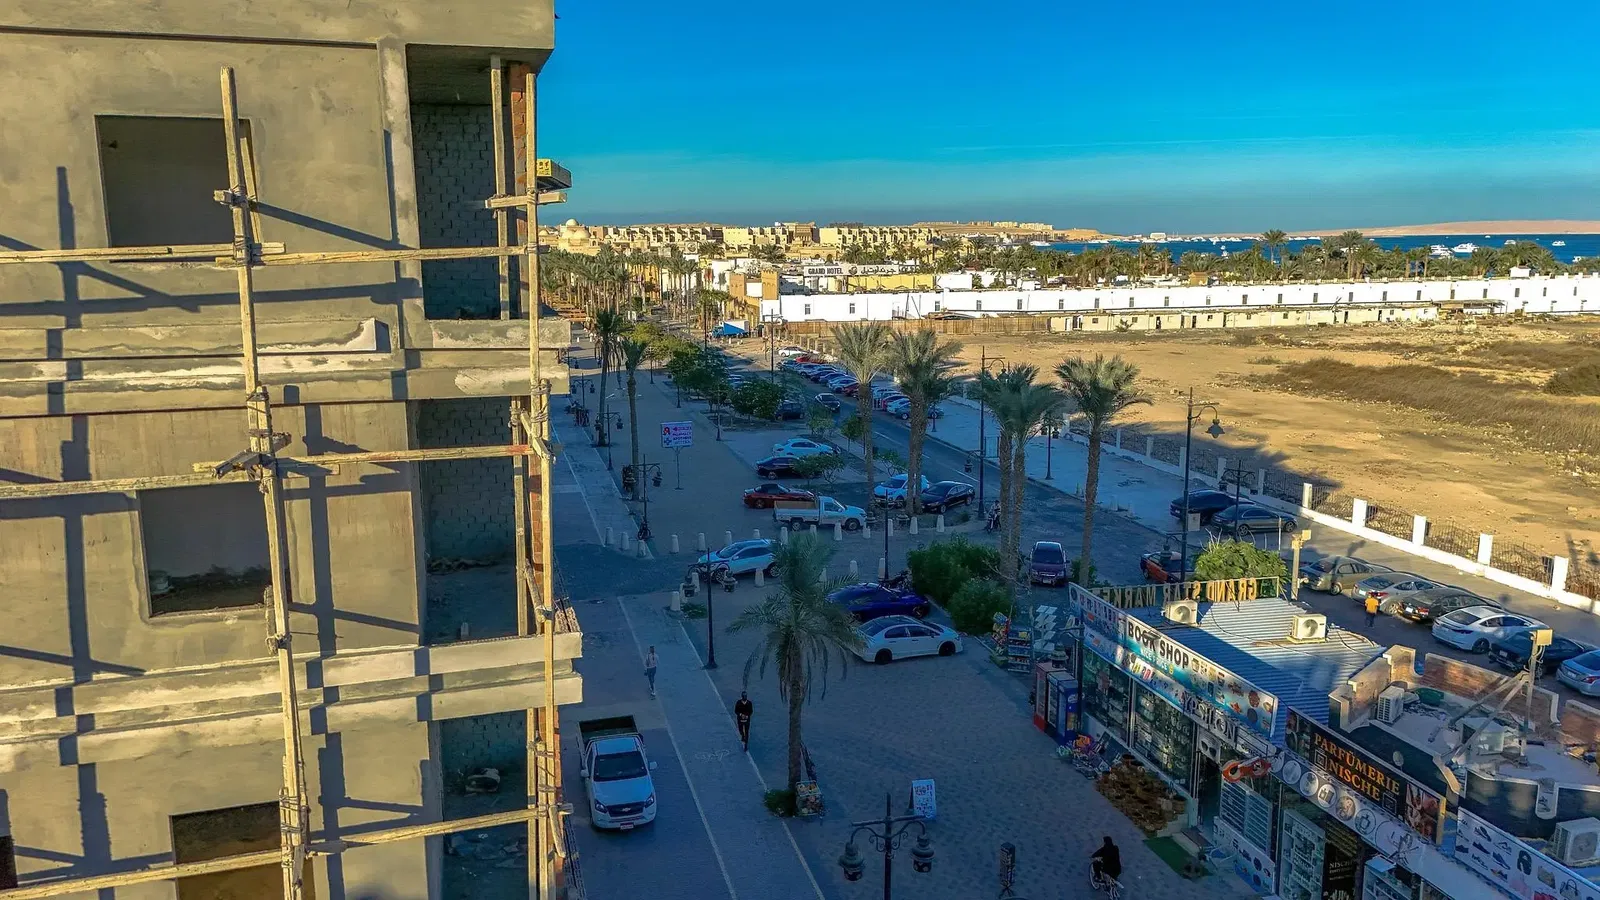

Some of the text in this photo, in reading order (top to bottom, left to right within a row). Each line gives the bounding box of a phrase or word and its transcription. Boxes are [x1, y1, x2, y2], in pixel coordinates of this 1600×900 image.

[827, 267, 844, 275] HOTEL
[1128, 621, 1156, 652] BOOK
[1159, 640, 1190, 668] SHOP
[1183, 692, 1236, 742] YPSILON
[1314, 733, 1400, 795] PARFÜMERIE
[1328, 758, 1381, 802] NISCHE
